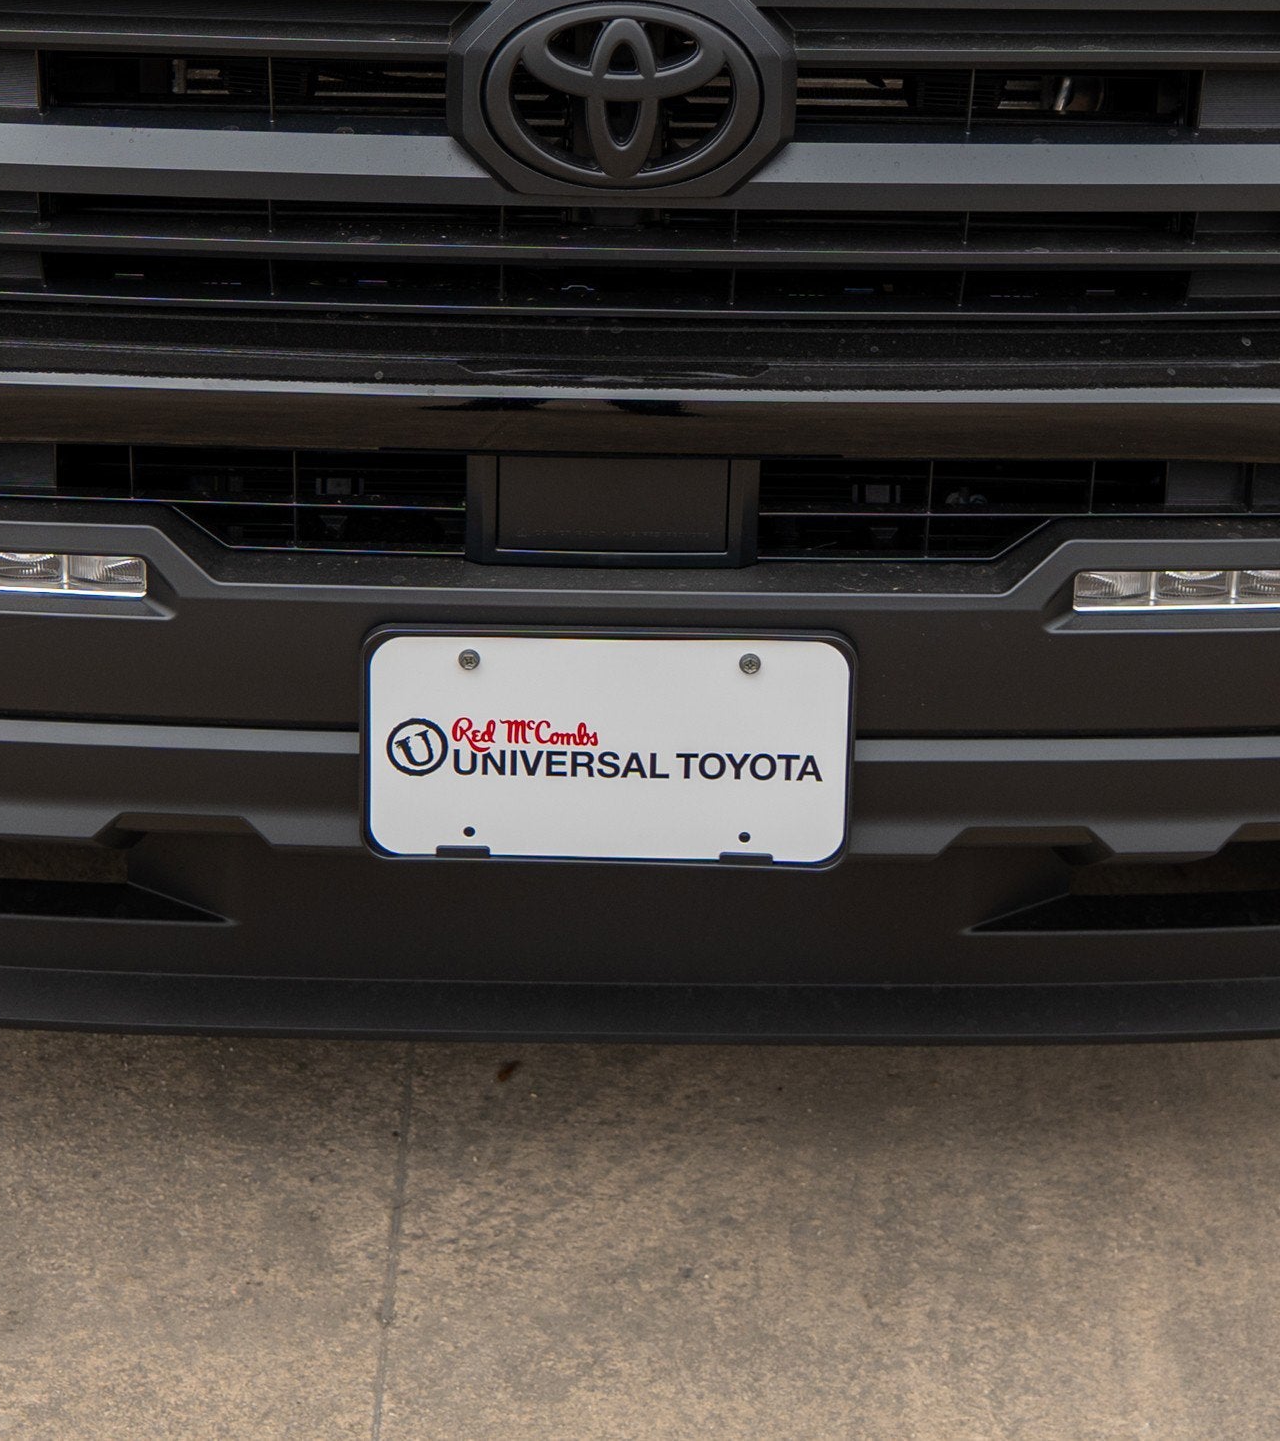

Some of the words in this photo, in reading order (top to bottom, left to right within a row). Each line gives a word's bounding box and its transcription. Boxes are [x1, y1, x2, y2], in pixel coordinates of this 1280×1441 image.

[451, 717, 497, 753] Red
[500, 718, 599, 747] McCombs
[453, 748, 670, 779] UNIVERSAL
[676, 753, 823, 782] TOYOTA
